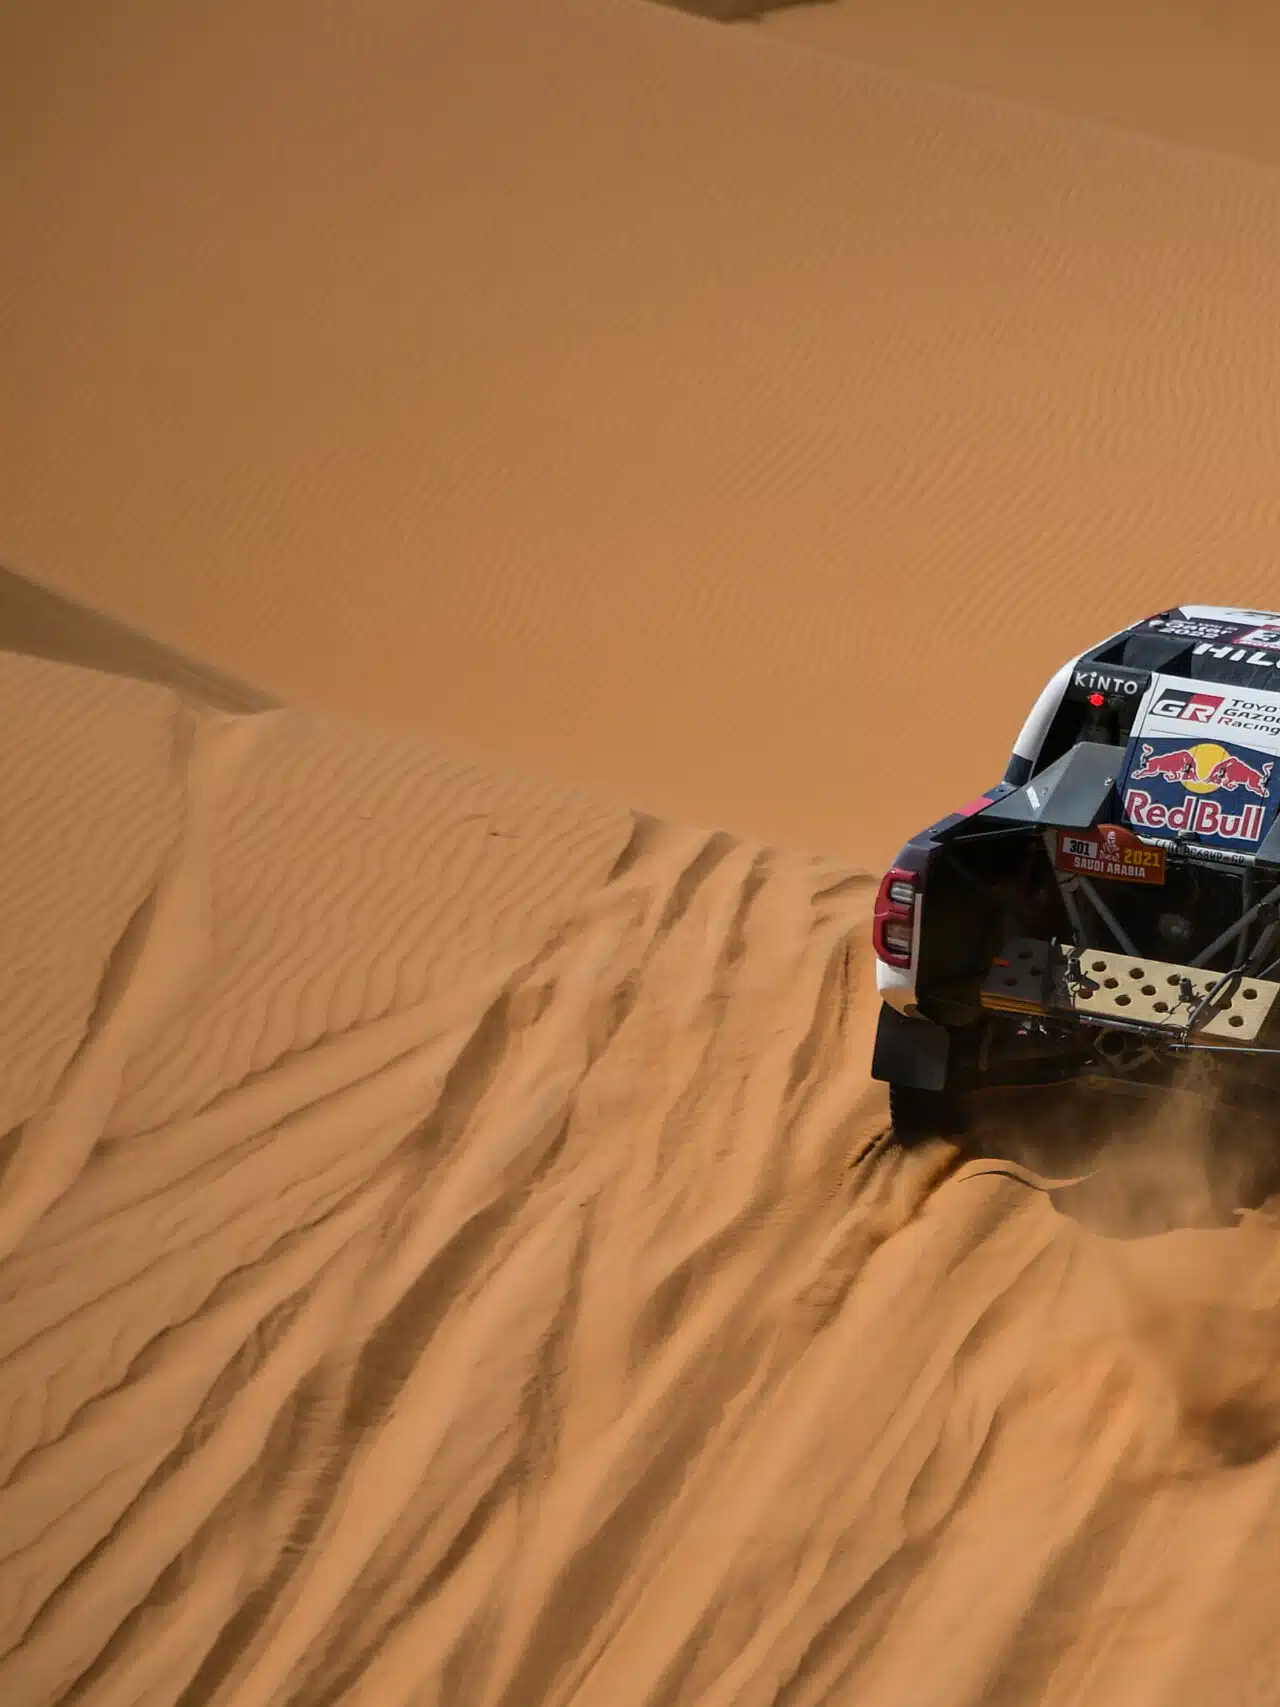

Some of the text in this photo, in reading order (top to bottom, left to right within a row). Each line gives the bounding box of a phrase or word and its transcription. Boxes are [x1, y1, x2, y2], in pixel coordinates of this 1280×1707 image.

[1158, 628, 1219, 639] 2022
[1152, 699, 1215, 723] GR
[1217, 716, 1280, 736] Racing
[1125, 789, 1266, 842] Red Bull
[1070, 840, 1091, 856] 301
[1123, 849, 1160, 867] 2021
[1074, 856, 1146, 879] SAUDI ARABIA
